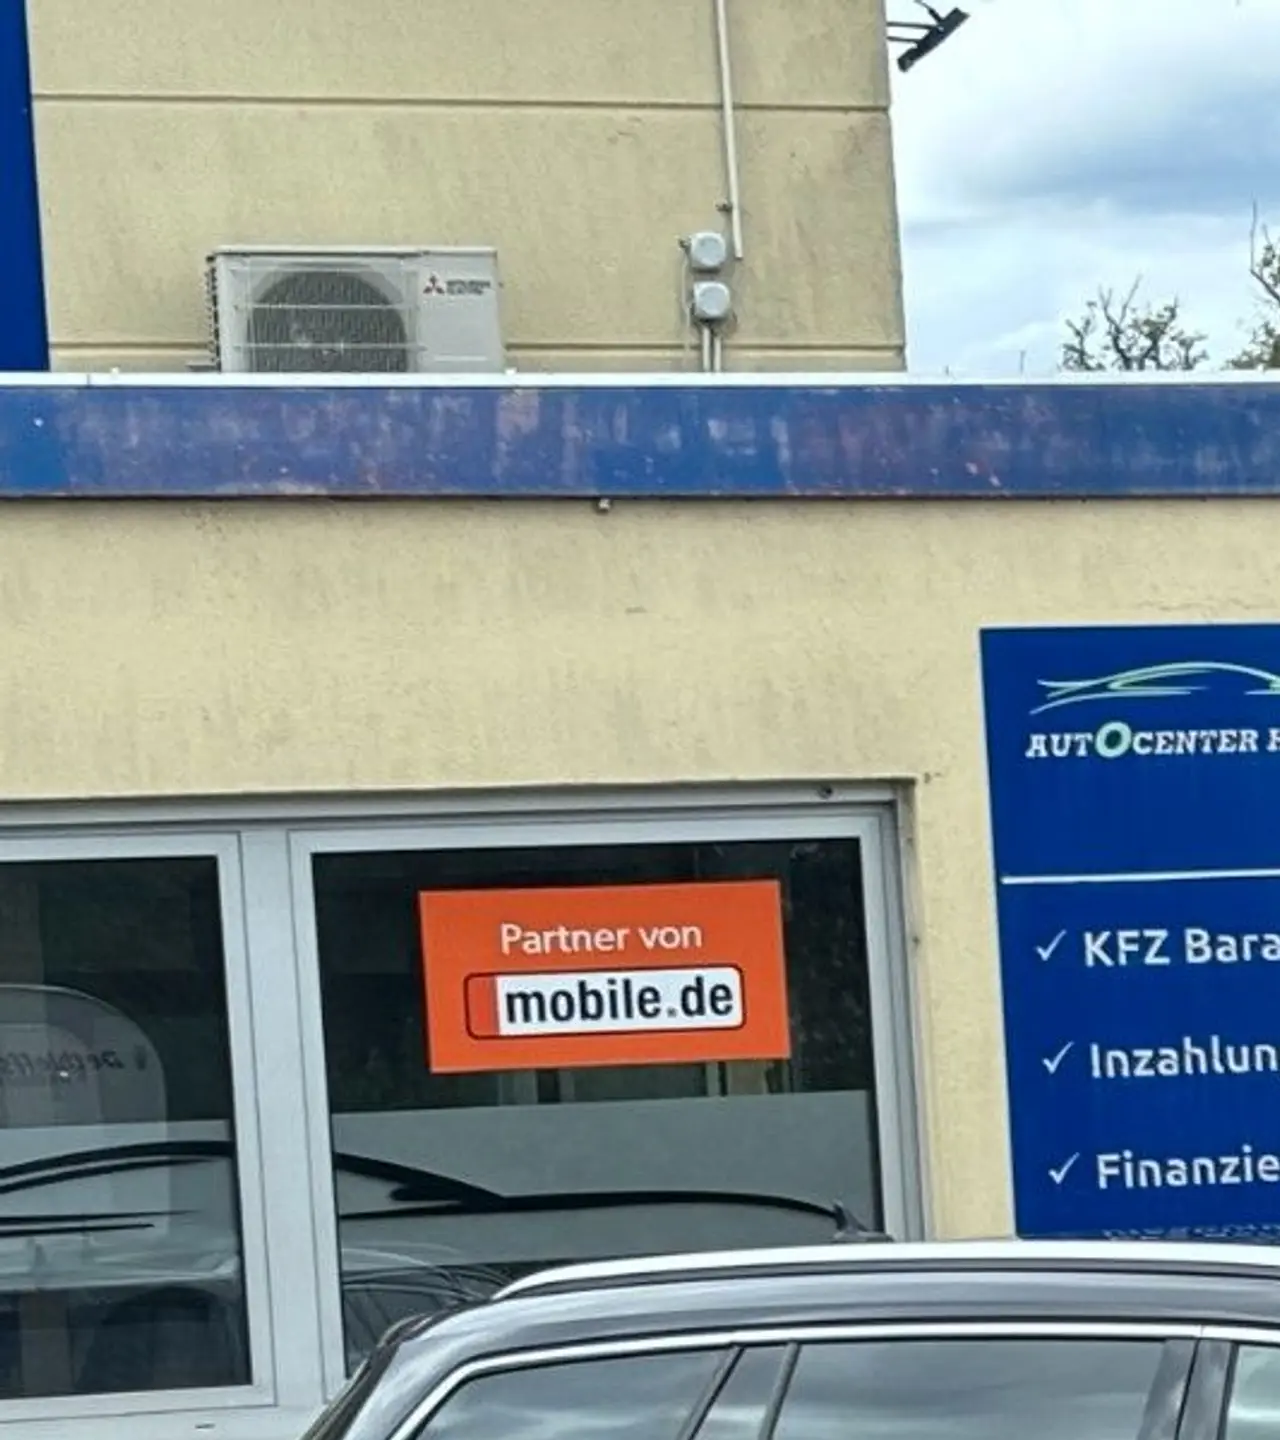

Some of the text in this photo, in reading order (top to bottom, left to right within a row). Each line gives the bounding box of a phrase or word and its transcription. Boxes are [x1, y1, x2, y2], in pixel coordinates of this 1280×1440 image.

[1025, 721, 1258, 758] AUTOCENTER
[500, 922, 703, 955] Partner von
[1083, 928, 1171, 968] KFZ
[505, 976, 734, 1024] mobile.de
